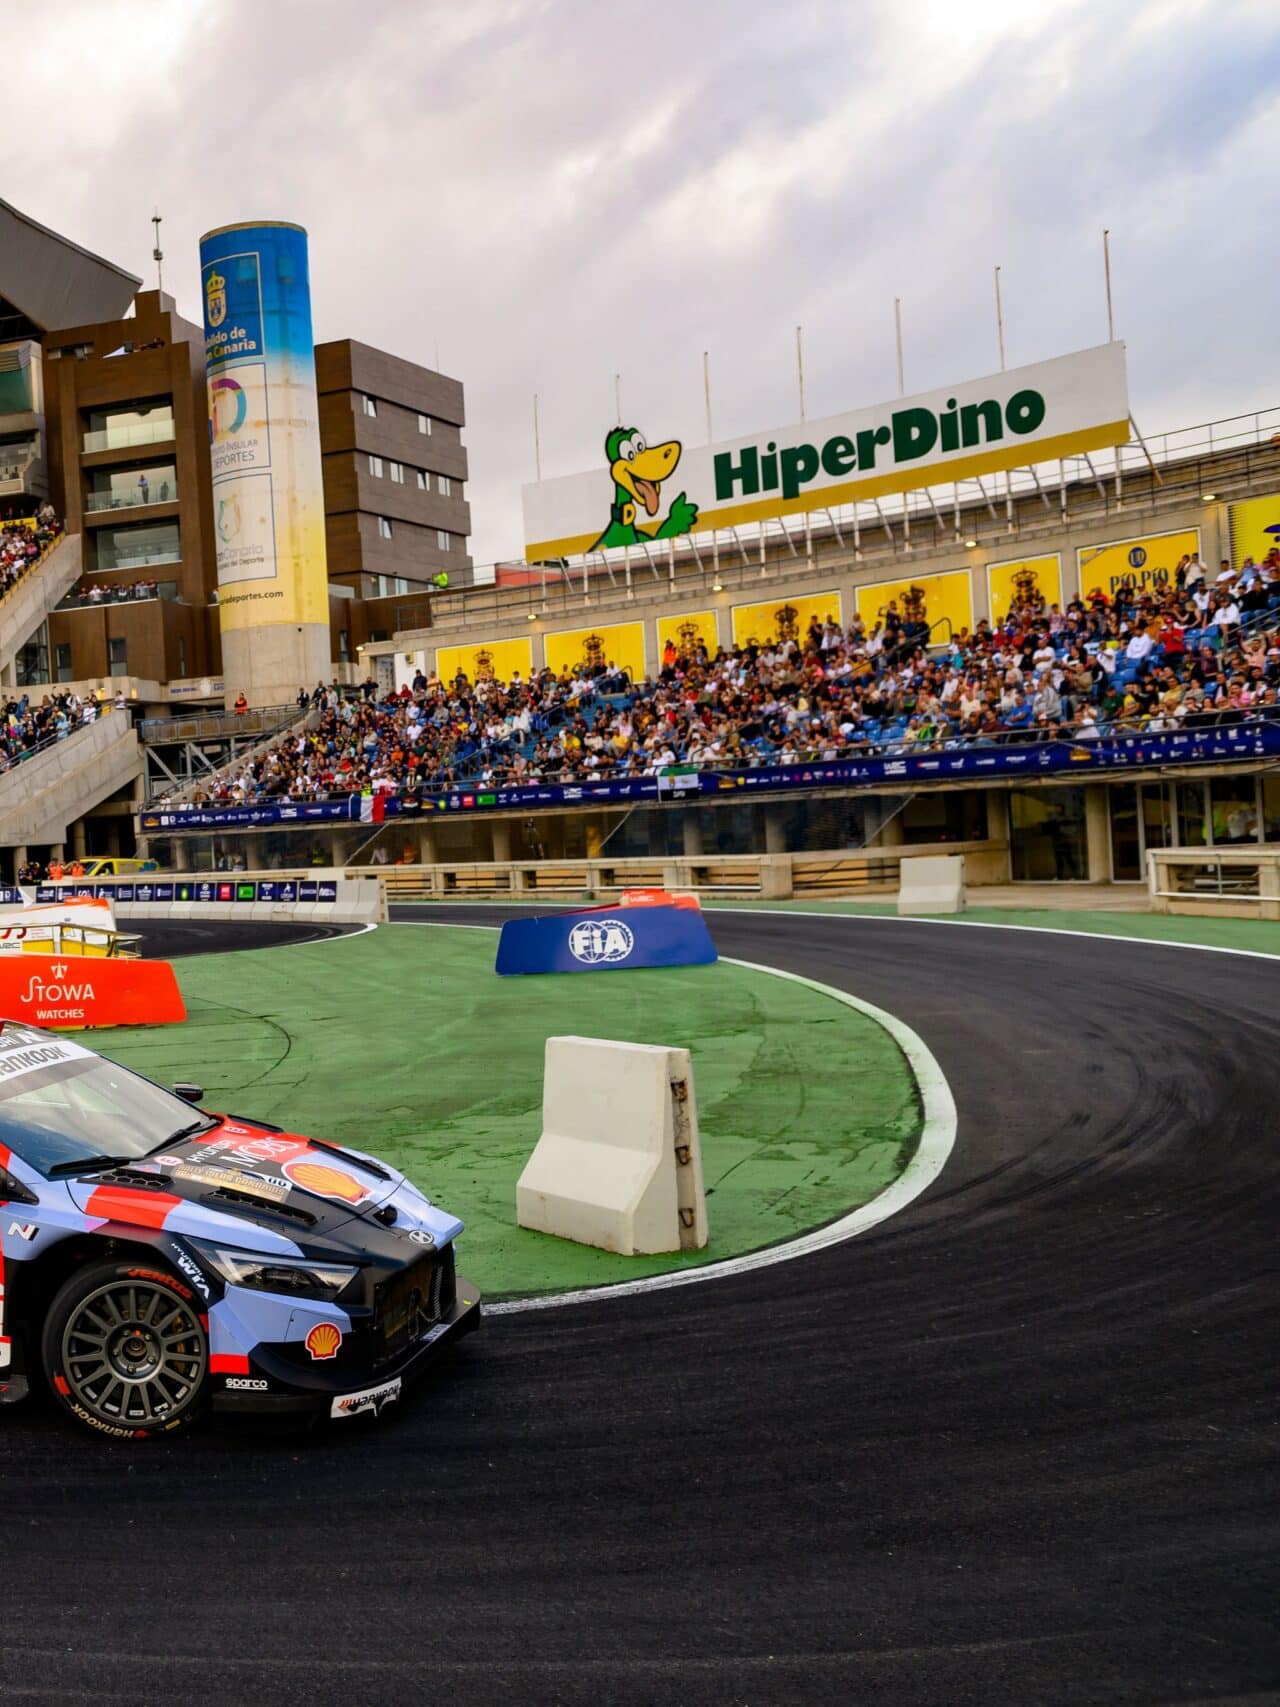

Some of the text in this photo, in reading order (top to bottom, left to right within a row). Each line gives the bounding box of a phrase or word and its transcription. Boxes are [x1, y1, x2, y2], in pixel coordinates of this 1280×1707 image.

[230, 326, 246, 339] de
[214, 339, 256, 357] Canaria
[714, 389, 1046, 500] HiperDino
[20, 975, 95, 1003] STOWA
[36, 1009, 85, 1019] WATCHES
[225, 1378, 268, 1390] sparco
